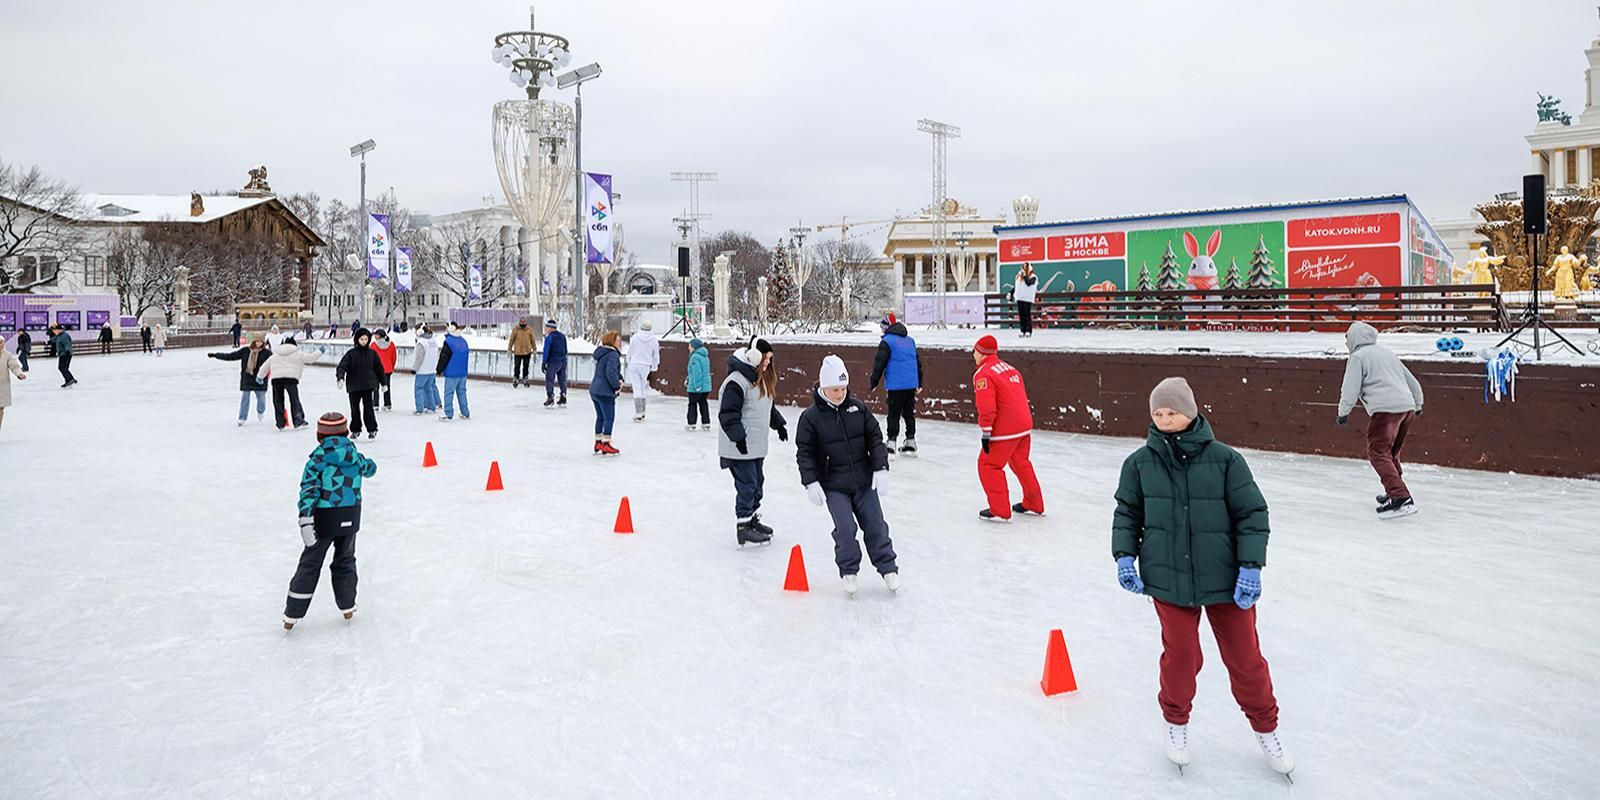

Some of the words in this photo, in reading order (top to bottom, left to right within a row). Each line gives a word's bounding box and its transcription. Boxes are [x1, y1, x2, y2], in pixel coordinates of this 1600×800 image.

[592, 223, 607, 231] сбп
[1304, 225, 1381, 238] KATOK.VDNH.RU
[1064, 235, 1109, 249] ЗИМА
[371, 248, 385, 256] сбп
[1072, 248, 1109, 257] МОСКВЕ
